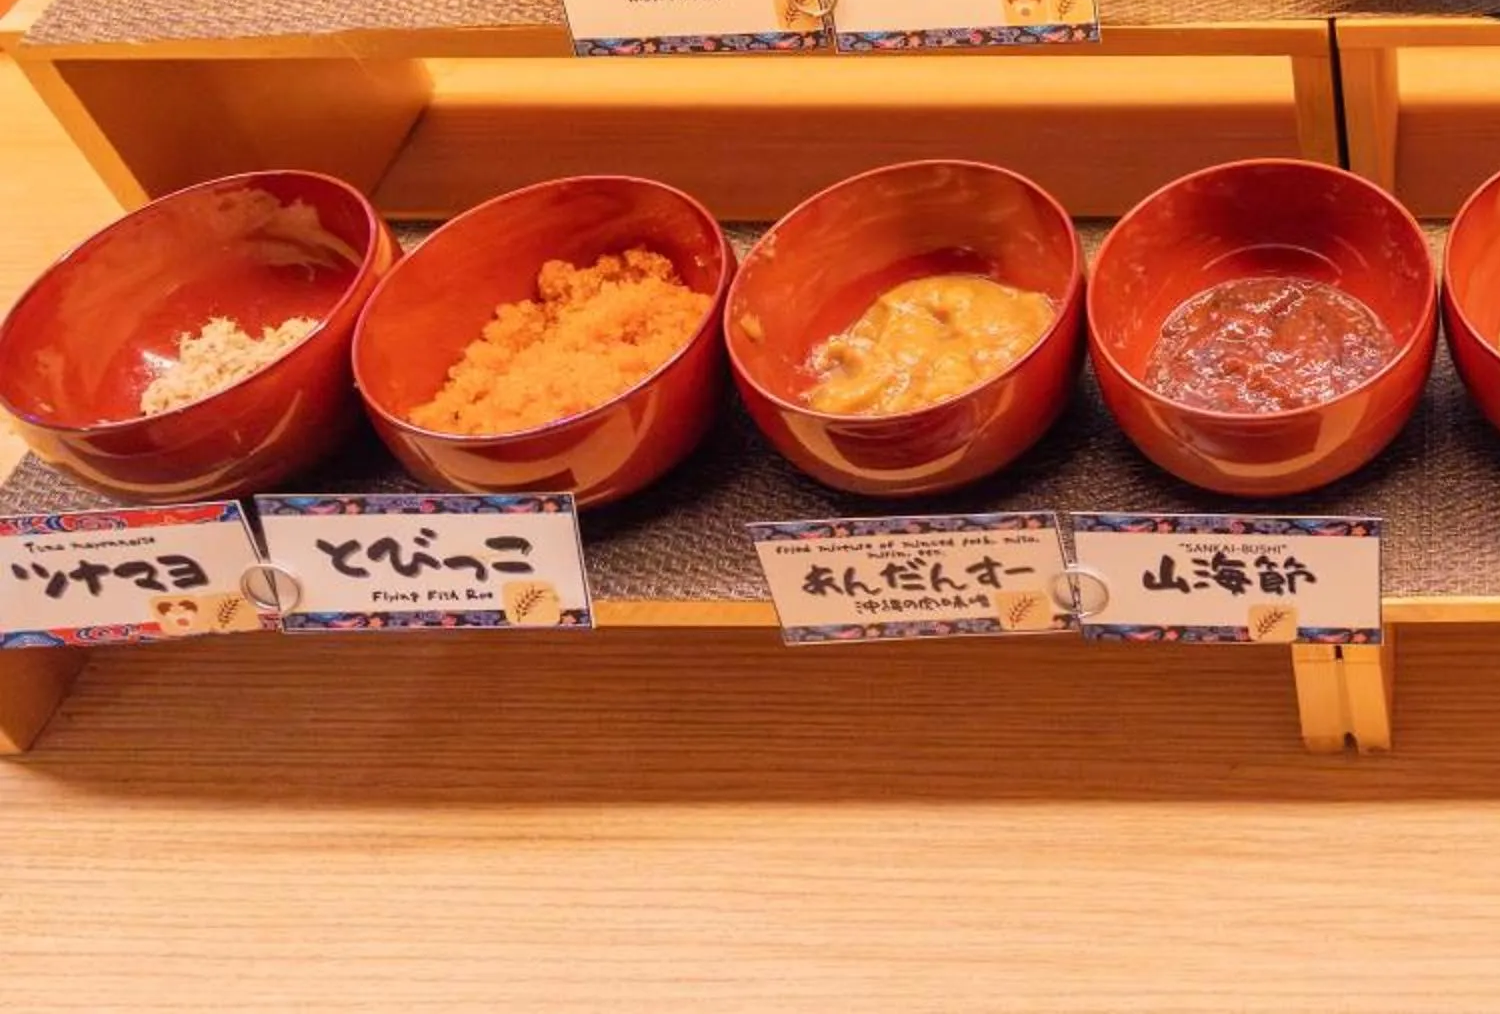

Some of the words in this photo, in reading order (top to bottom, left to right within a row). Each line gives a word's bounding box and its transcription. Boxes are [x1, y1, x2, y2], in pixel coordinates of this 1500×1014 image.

[316, 528, 534, 580] とびっこ
[1143, 552, 1316, 595] 山海節
[11, 555, 209, 598] ツナマヨ
[372, 591, 420, 603] Flying
[428, 589, 459, 601] Fish
[802, 556, 1034, 597] あんだんすー
